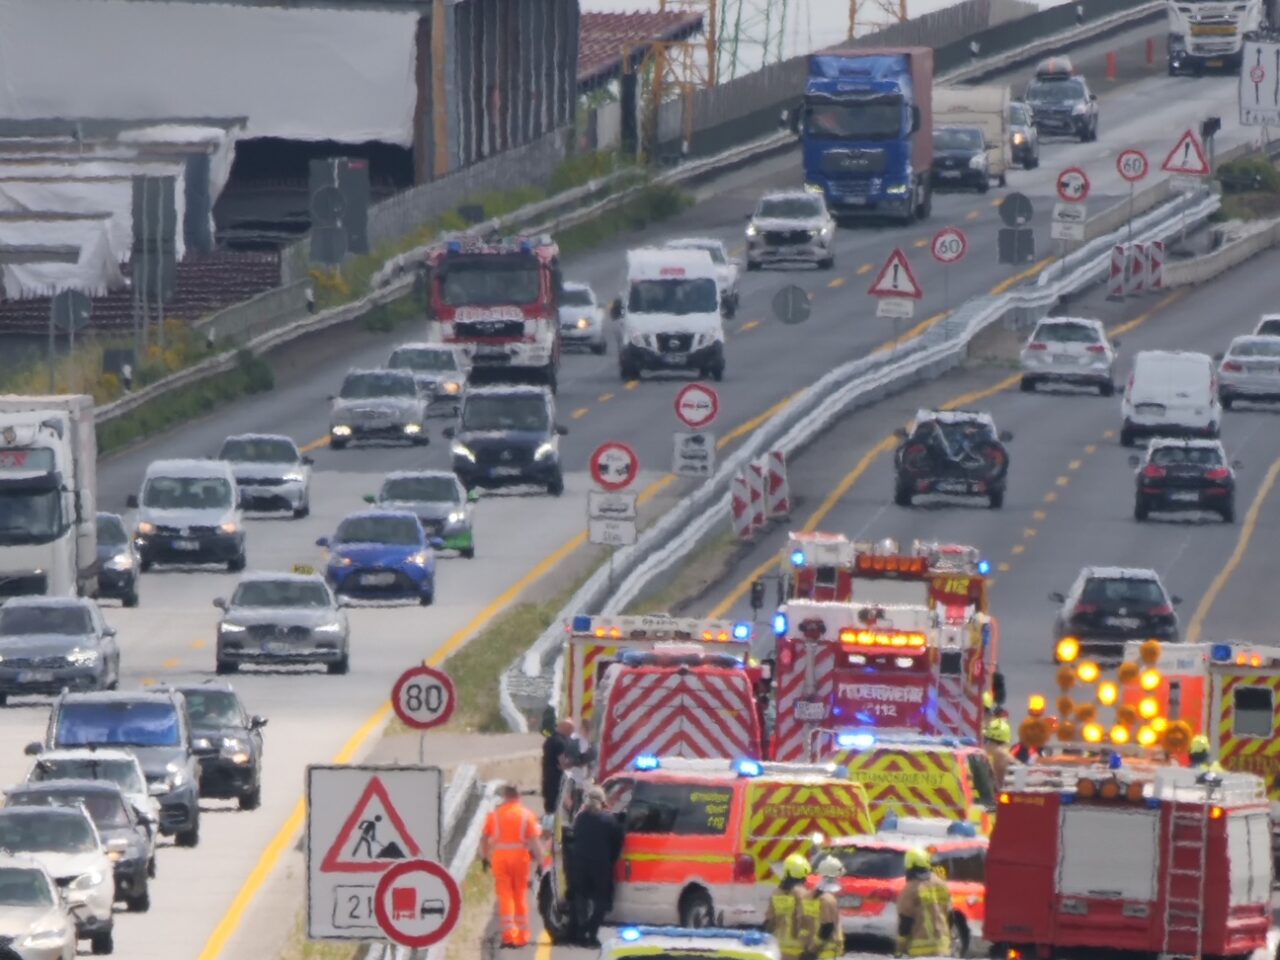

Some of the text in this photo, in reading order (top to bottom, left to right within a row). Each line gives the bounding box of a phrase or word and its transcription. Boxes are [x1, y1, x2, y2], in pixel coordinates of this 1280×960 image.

[1124, 158, 1142, 172] 60
[939, 239, 960, 254] 60
[405, 683, 443, 713] 80
